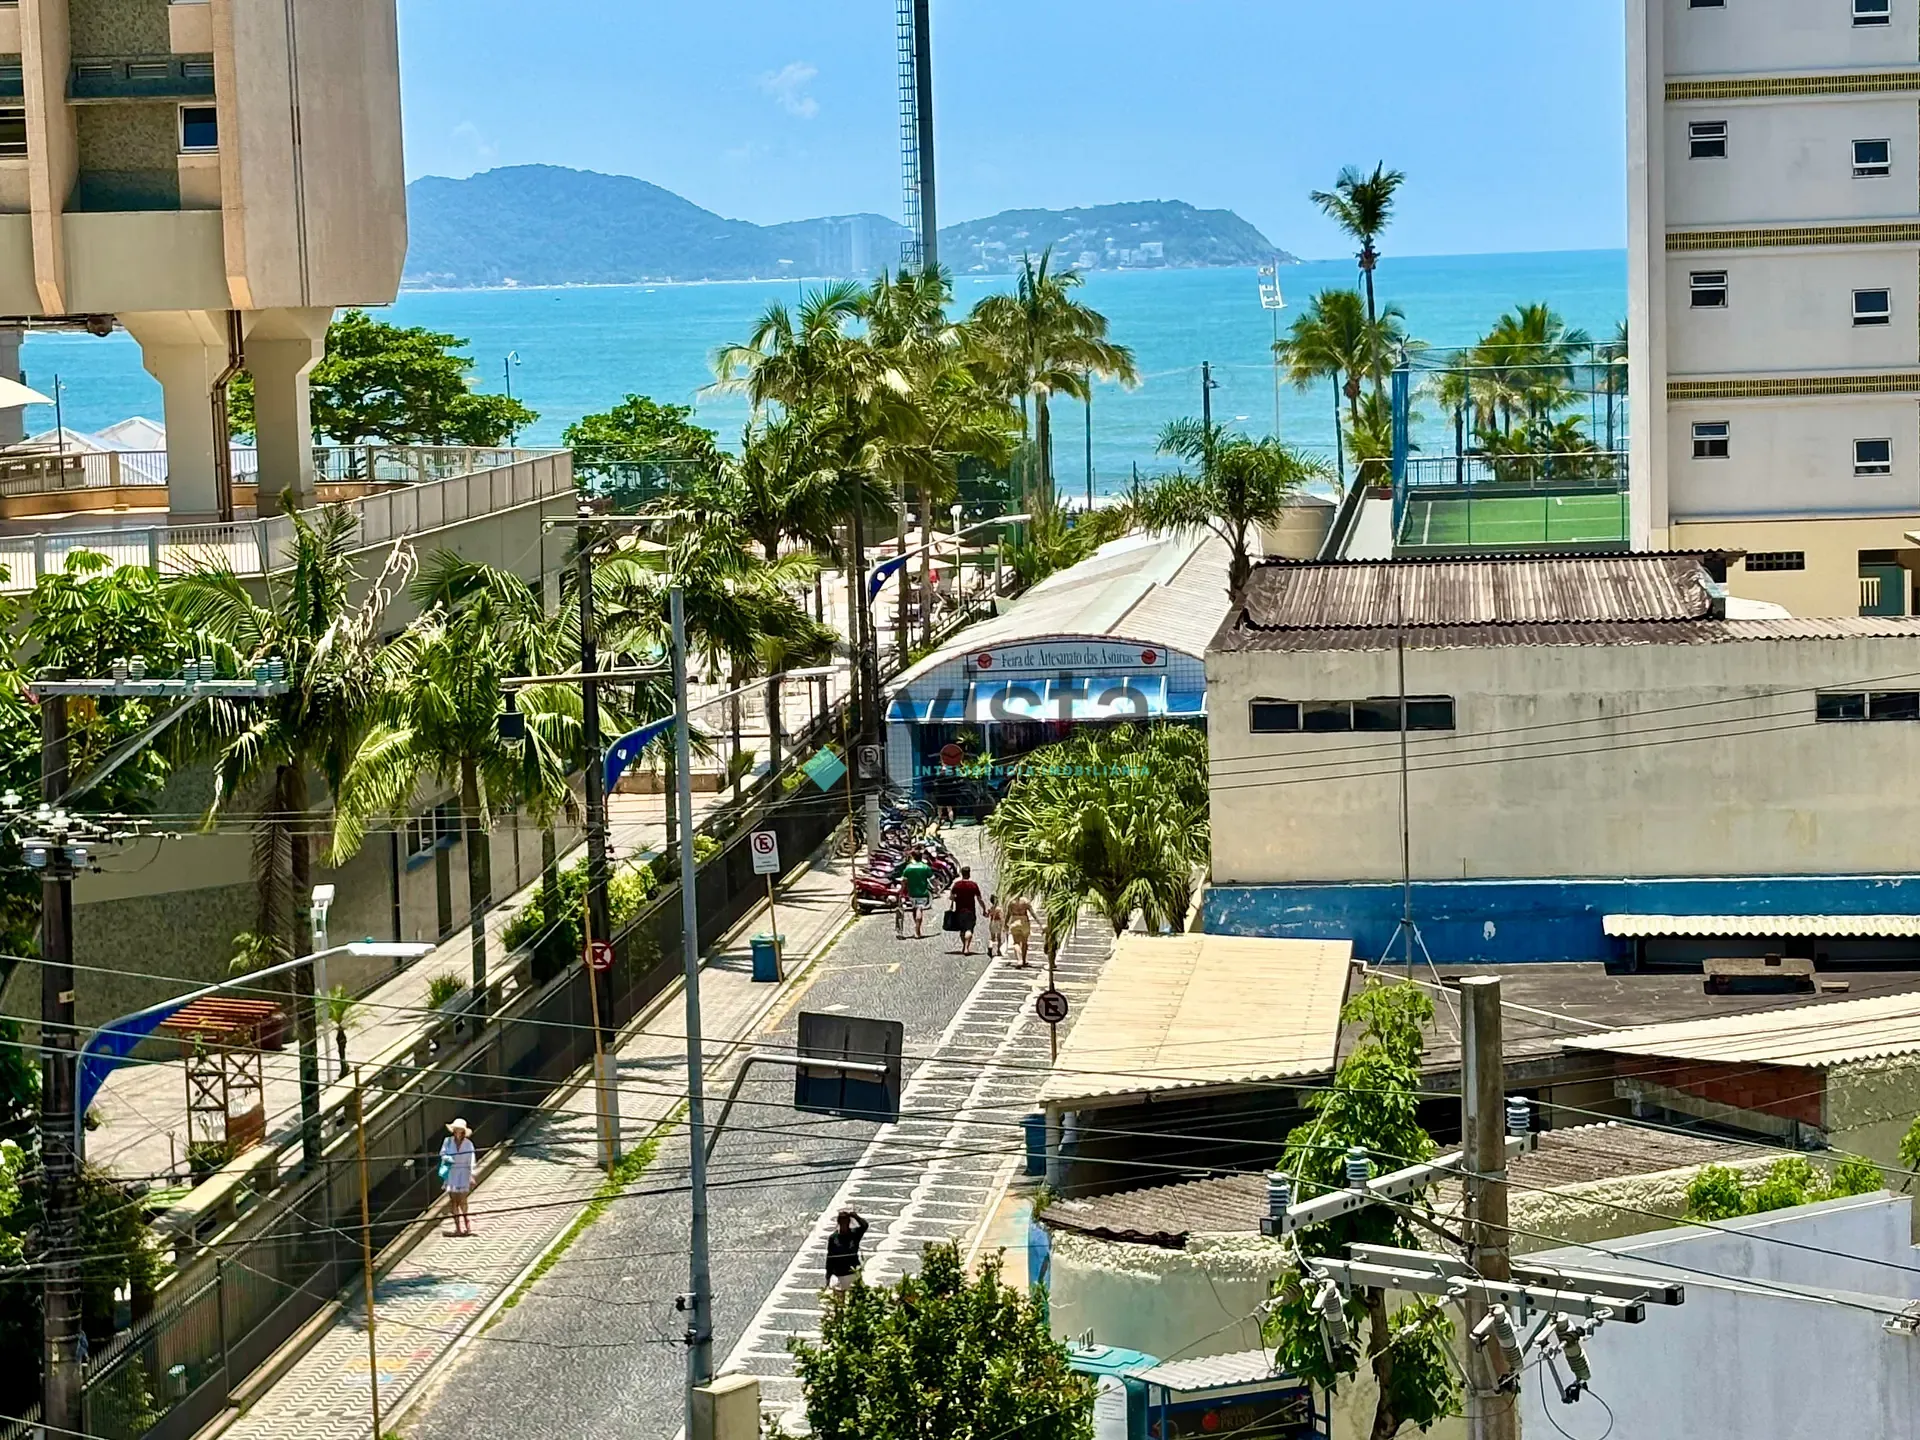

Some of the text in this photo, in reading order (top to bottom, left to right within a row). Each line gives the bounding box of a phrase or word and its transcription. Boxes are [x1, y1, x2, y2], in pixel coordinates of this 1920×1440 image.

[1001, 652, 1023, 668] Feira
[1024, 648, 1035, 666] de
[1039, 648, 1082, 666] Artesanato
[1084, 647, 1098, 665] das
